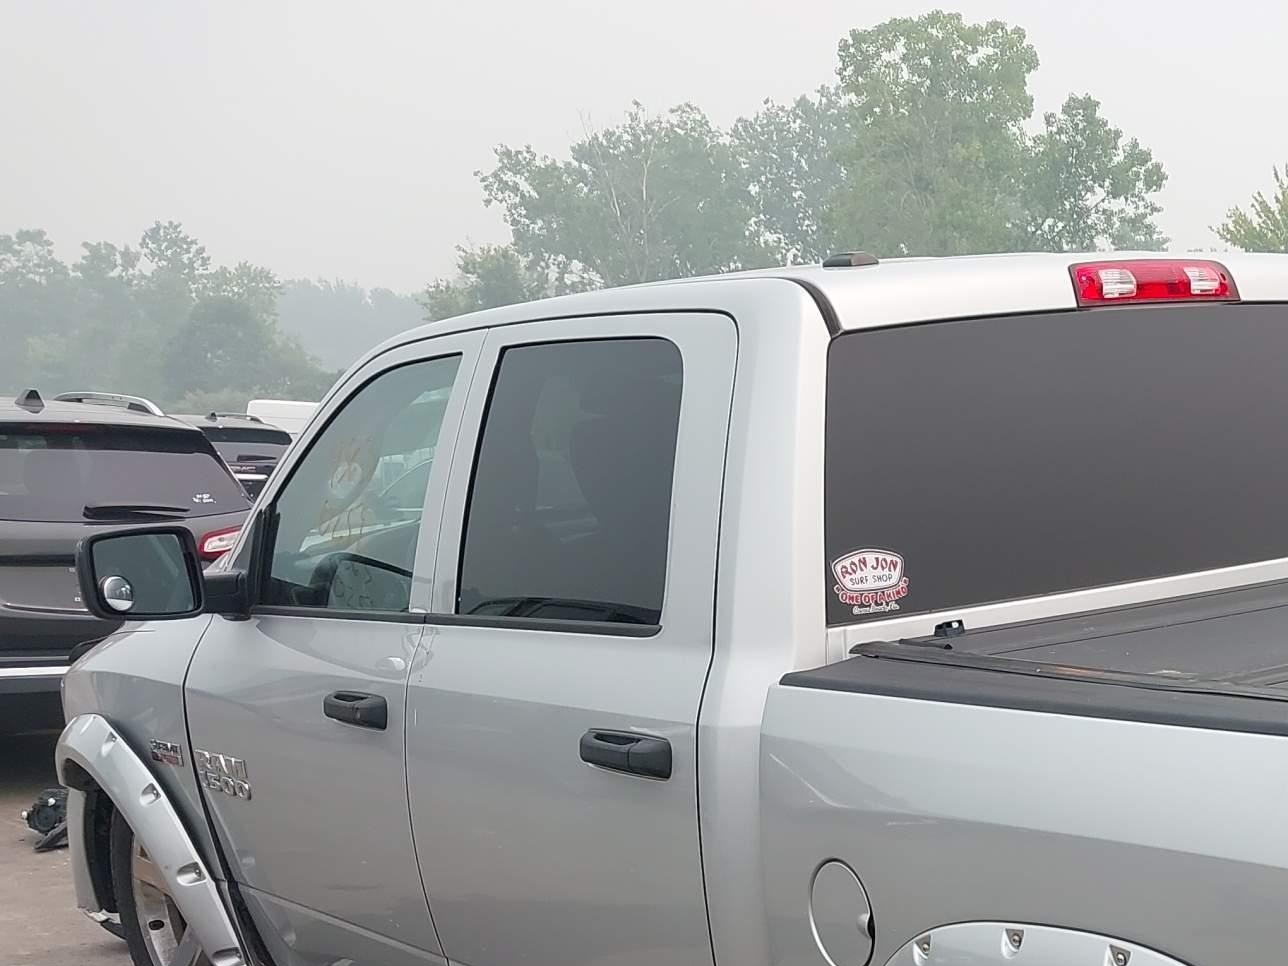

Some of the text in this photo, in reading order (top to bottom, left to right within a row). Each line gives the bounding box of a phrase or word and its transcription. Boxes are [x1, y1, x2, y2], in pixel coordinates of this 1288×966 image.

[840, 556, 898, 579] RON JON
[849, 576, 869, 586] SURF
[872, 573, 893, 584] SHOP
[839, 585, 908, 605] ONE OF A KIND
[194, 749, 249, 779] RAM
